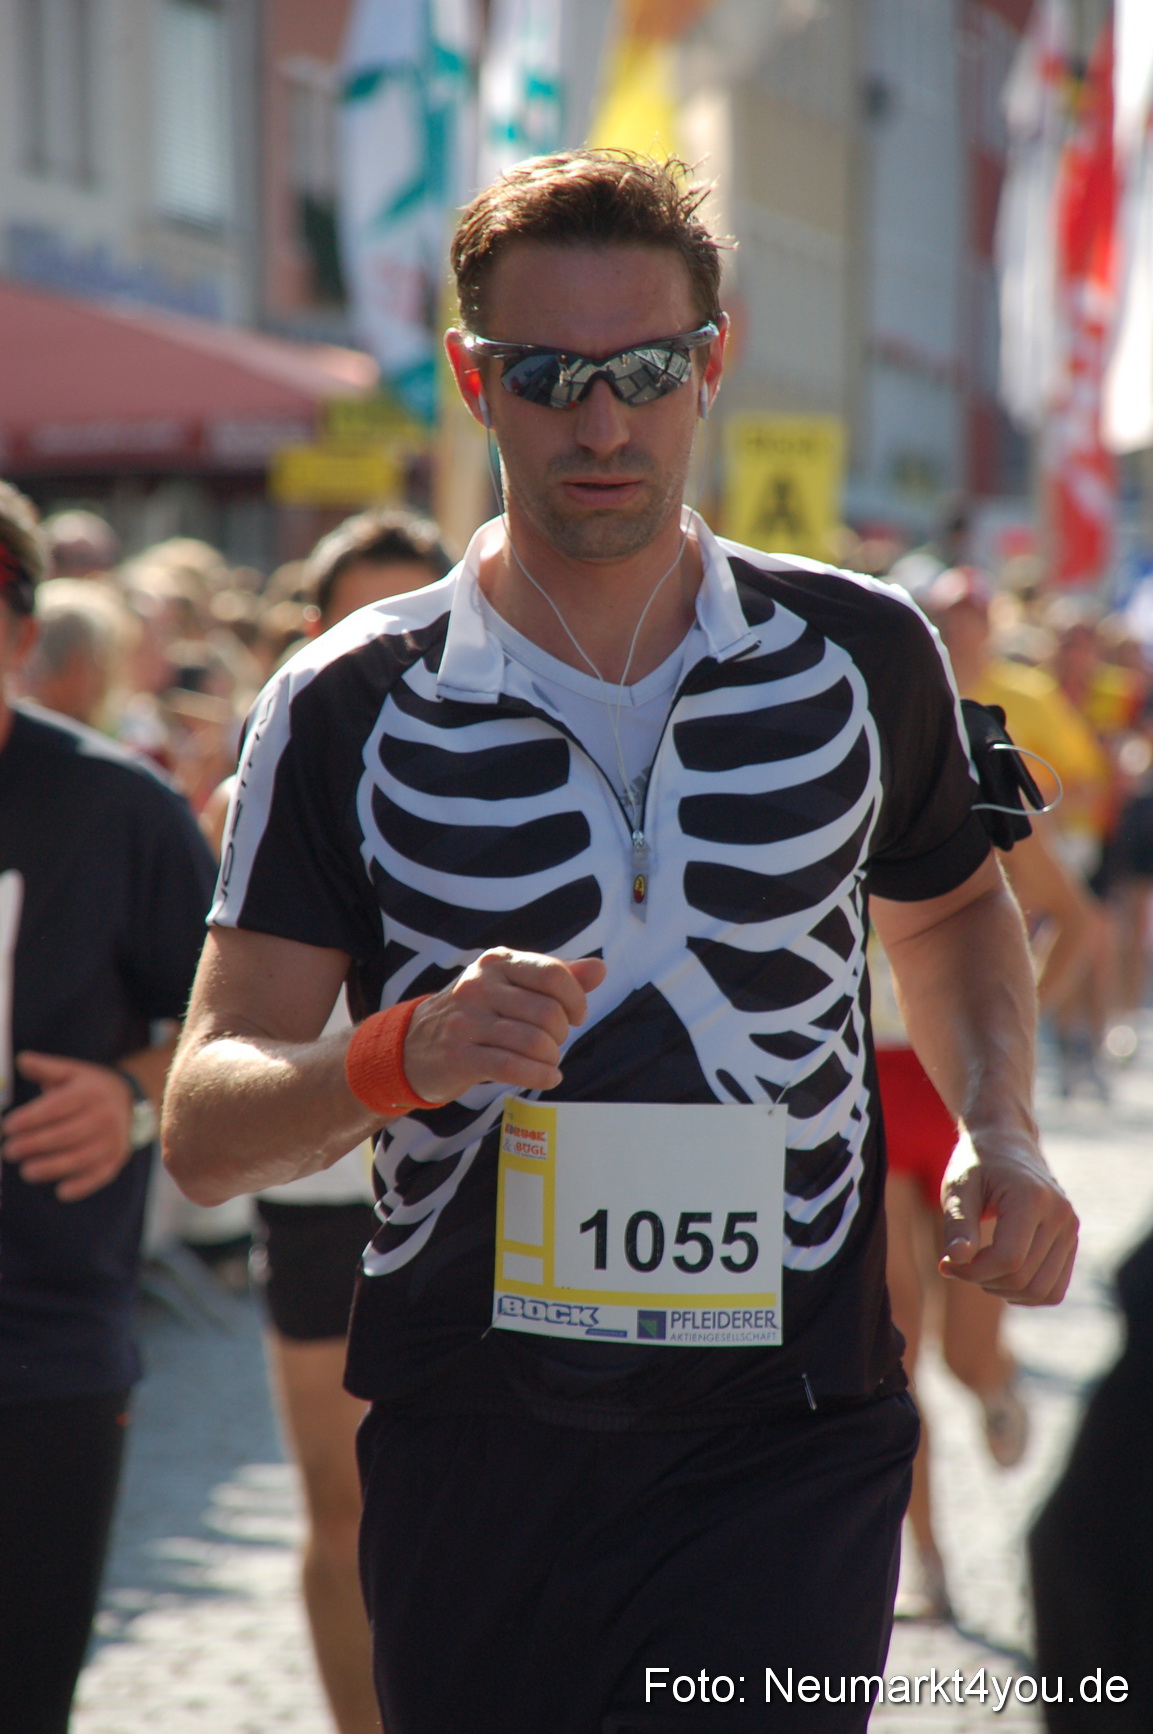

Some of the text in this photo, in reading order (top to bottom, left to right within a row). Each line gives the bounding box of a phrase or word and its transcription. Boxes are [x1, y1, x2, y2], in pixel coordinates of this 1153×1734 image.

[579, 1208, 759, 1274] 1055
[497, 1295, 600, 1328] BOCK
[670, 1310, 779, 1330] PFLEIDERER
[670, 1331, 777, 1343] AKTIENGESELLSCHAFT
